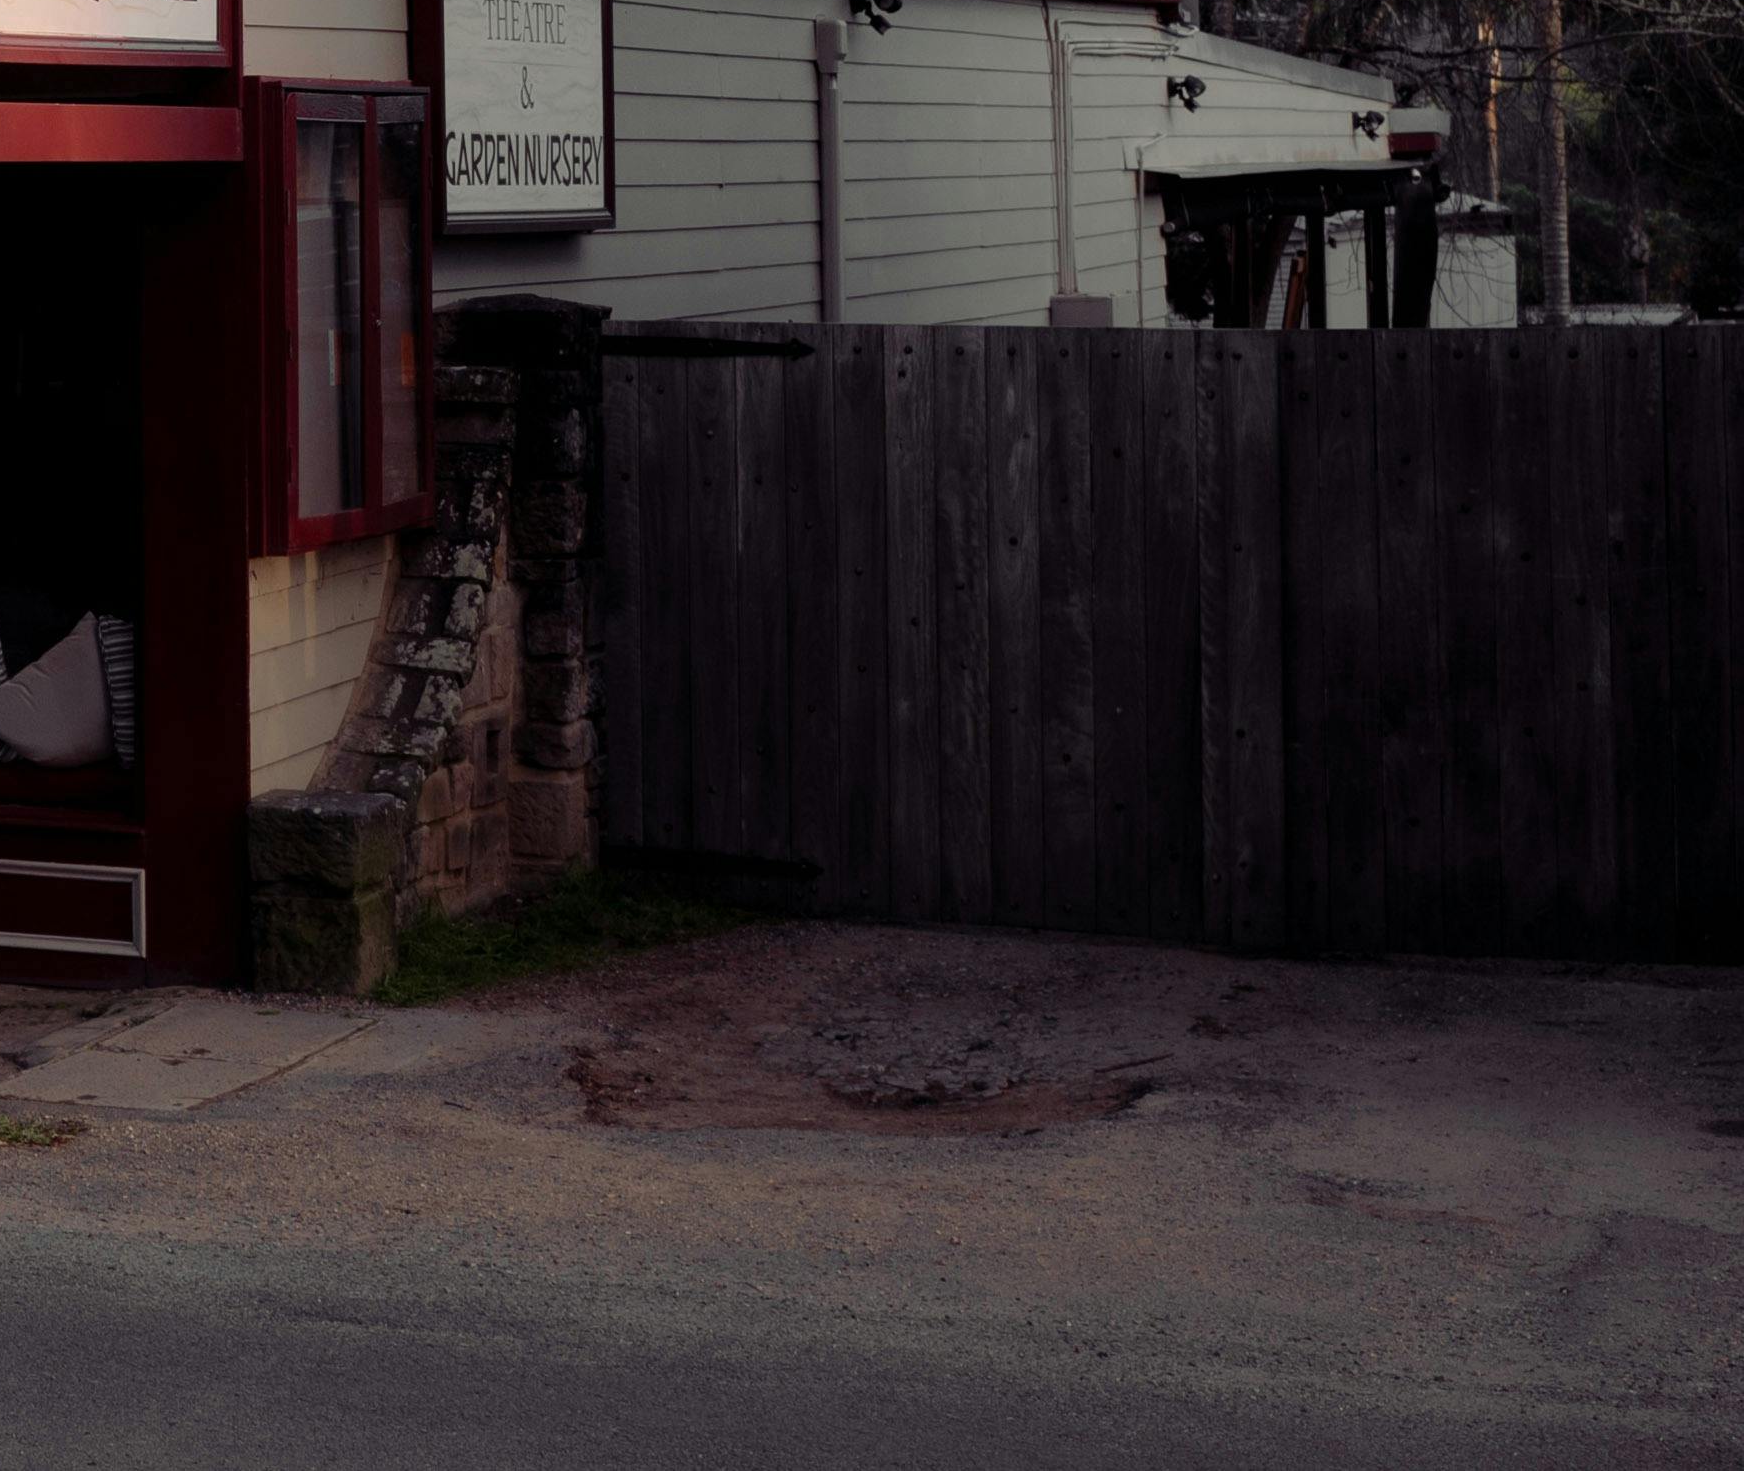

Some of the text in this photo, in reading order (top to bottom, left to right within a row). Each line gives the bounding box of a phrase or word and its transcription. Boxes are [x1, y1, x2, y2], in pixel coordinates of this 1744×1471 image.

[520, 66, 535, 109] &
[445, 130, 603, 187] GARDEN NURSERY
